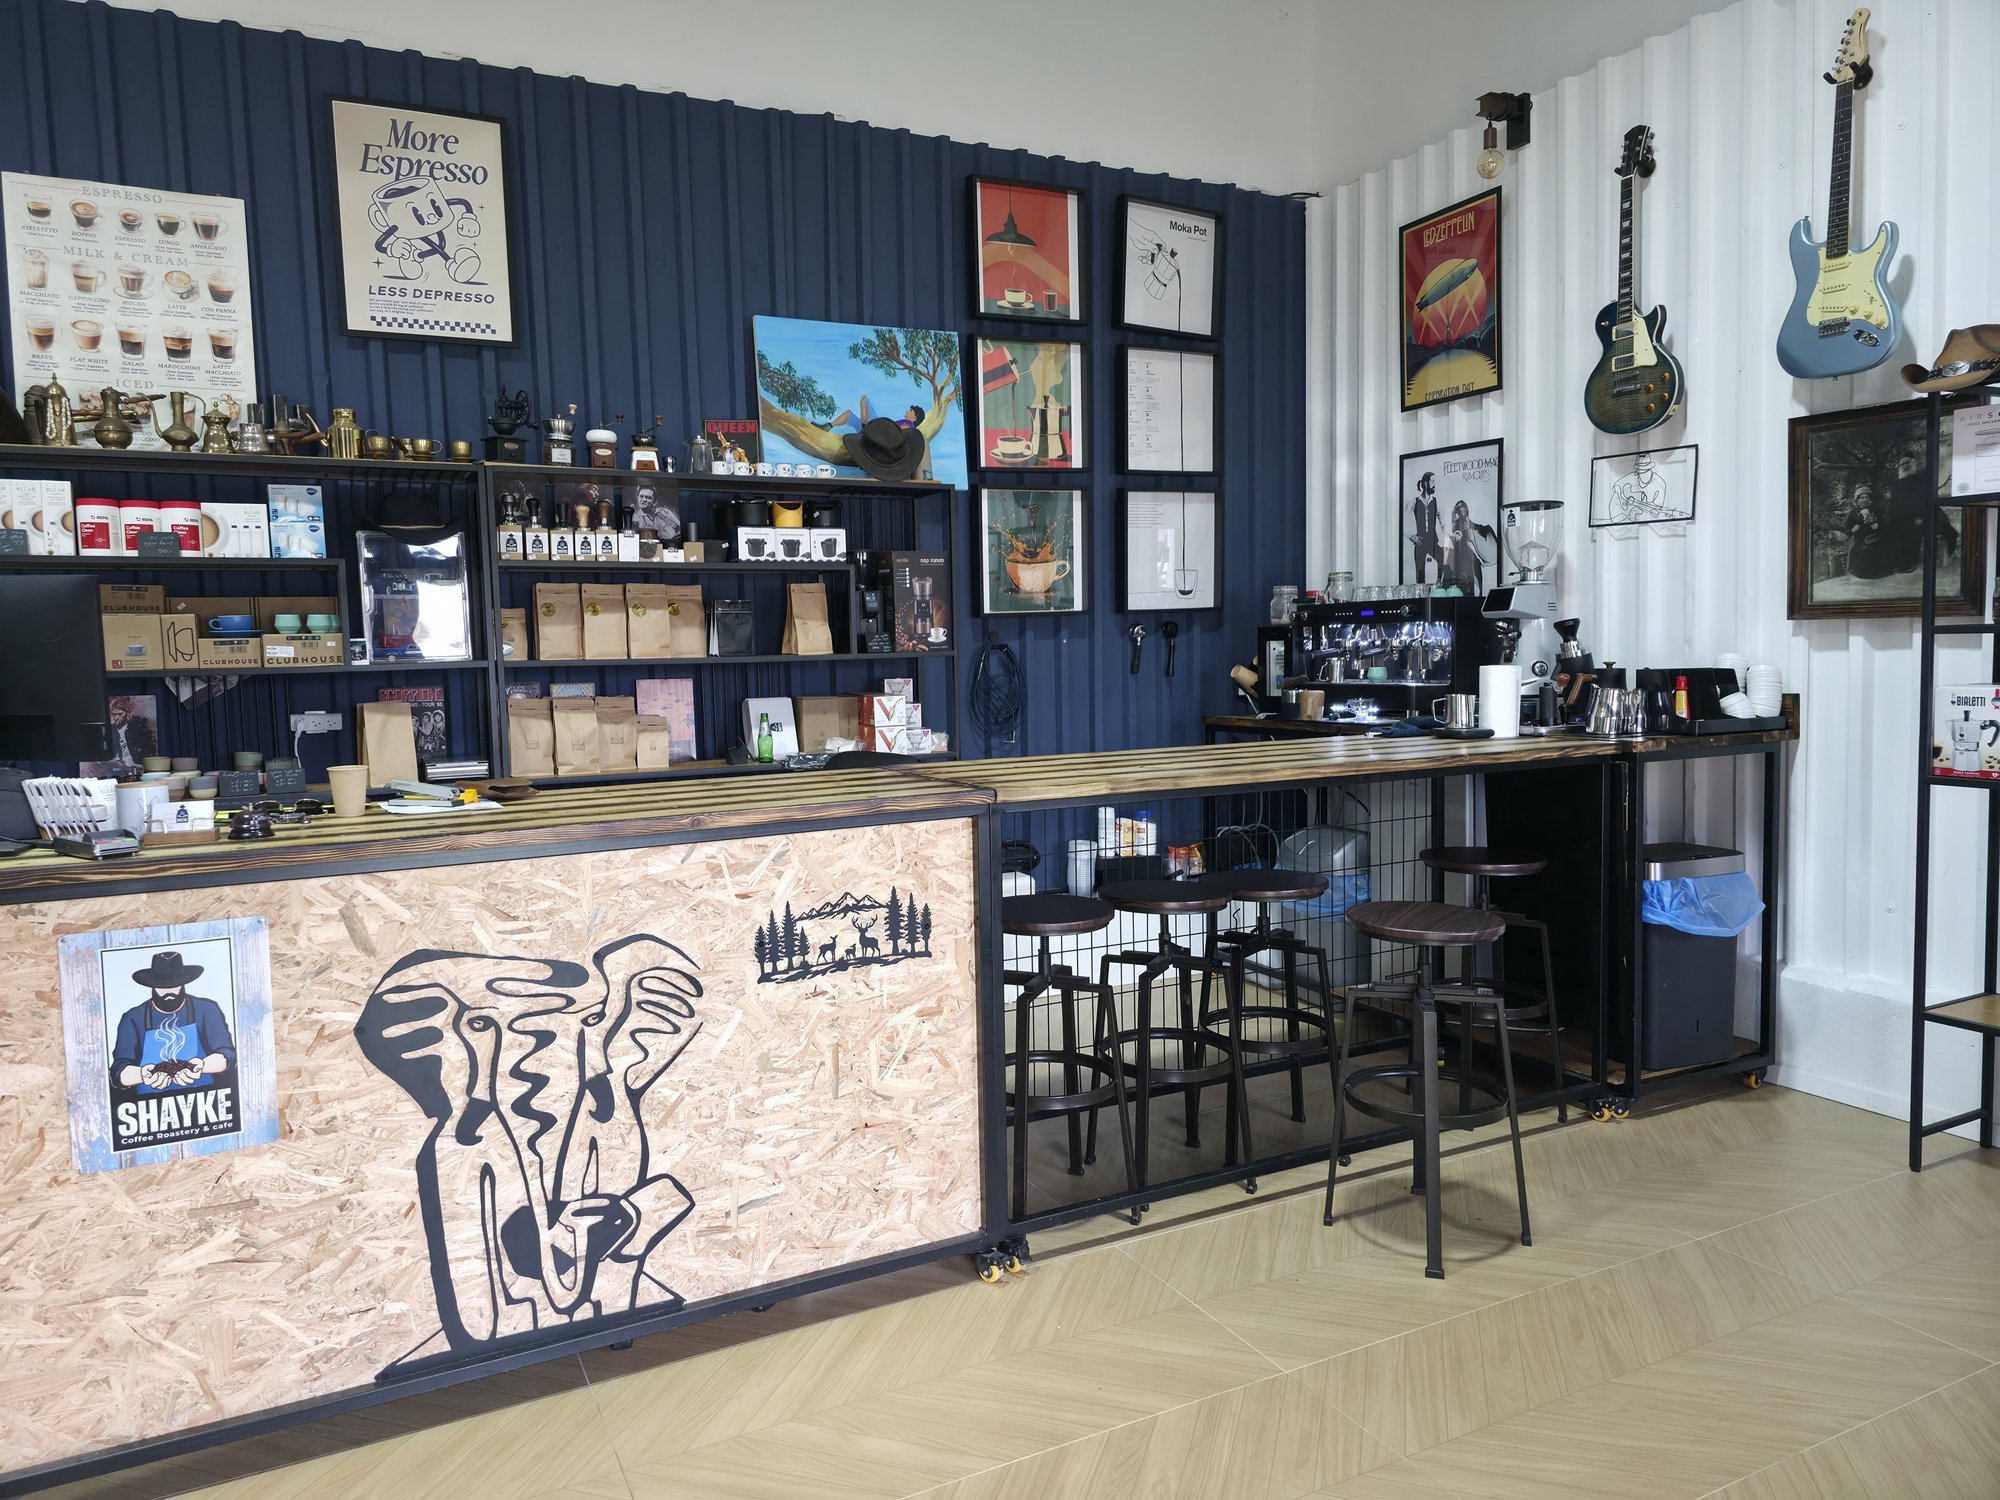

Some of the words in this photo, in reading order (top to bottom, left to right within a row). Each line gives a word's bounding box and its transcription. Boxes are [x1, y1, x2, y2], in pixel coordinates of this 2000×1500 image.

[386, 118, 460, 155] More
[358, 143, 489, 185] Espresso
[82, 186, 163, 204] ESPRESSO
[21, 224, 58, 234] RISTRETTO
[71, 230, 97, 238] DOPPIO
[1169, 220, 1192, 234] Moka
[1193, 225, 1207, 237] Pot
[114, 235, 146, 243] ESPRESSO
[190, 243, 227, 251] AMERICANO
[63, 246, 105, 260] MILK
[114, 251, 123, 261] &
[132, 254, 190, 267] CREAM
[19, 290, 60, 299] MACCHIATO
[68, 295, 110, 303] CAPPUCCINO
[368, 285, 408, 298] LESS
[413, 288, 495, 304] DEPRESSO
[157, 363, 201, 371] MAROCCHINO
[115, 378, 154, 390] ICED
[1462, 381, 1475, 393] DAY
[706, 421, 756, 434] QUEEN
[1443, 458, 1483, 476] FLEETWOOD
[103, 604, 161, 612] CLUBHOUSE
[203, 658, 259, 666] CLUBHOUSE
[267, 655, 343, 665] CLUBHOUSE
[1956, 696, 1986, 707] BIALETTI
[117, 1087, 233, 1137] SHAYKE
[121, 1134, 154, 1145] Coffee
[157, 1126, 200, 1139] Roastery
[212, 1121, 234, 1130] cafe
